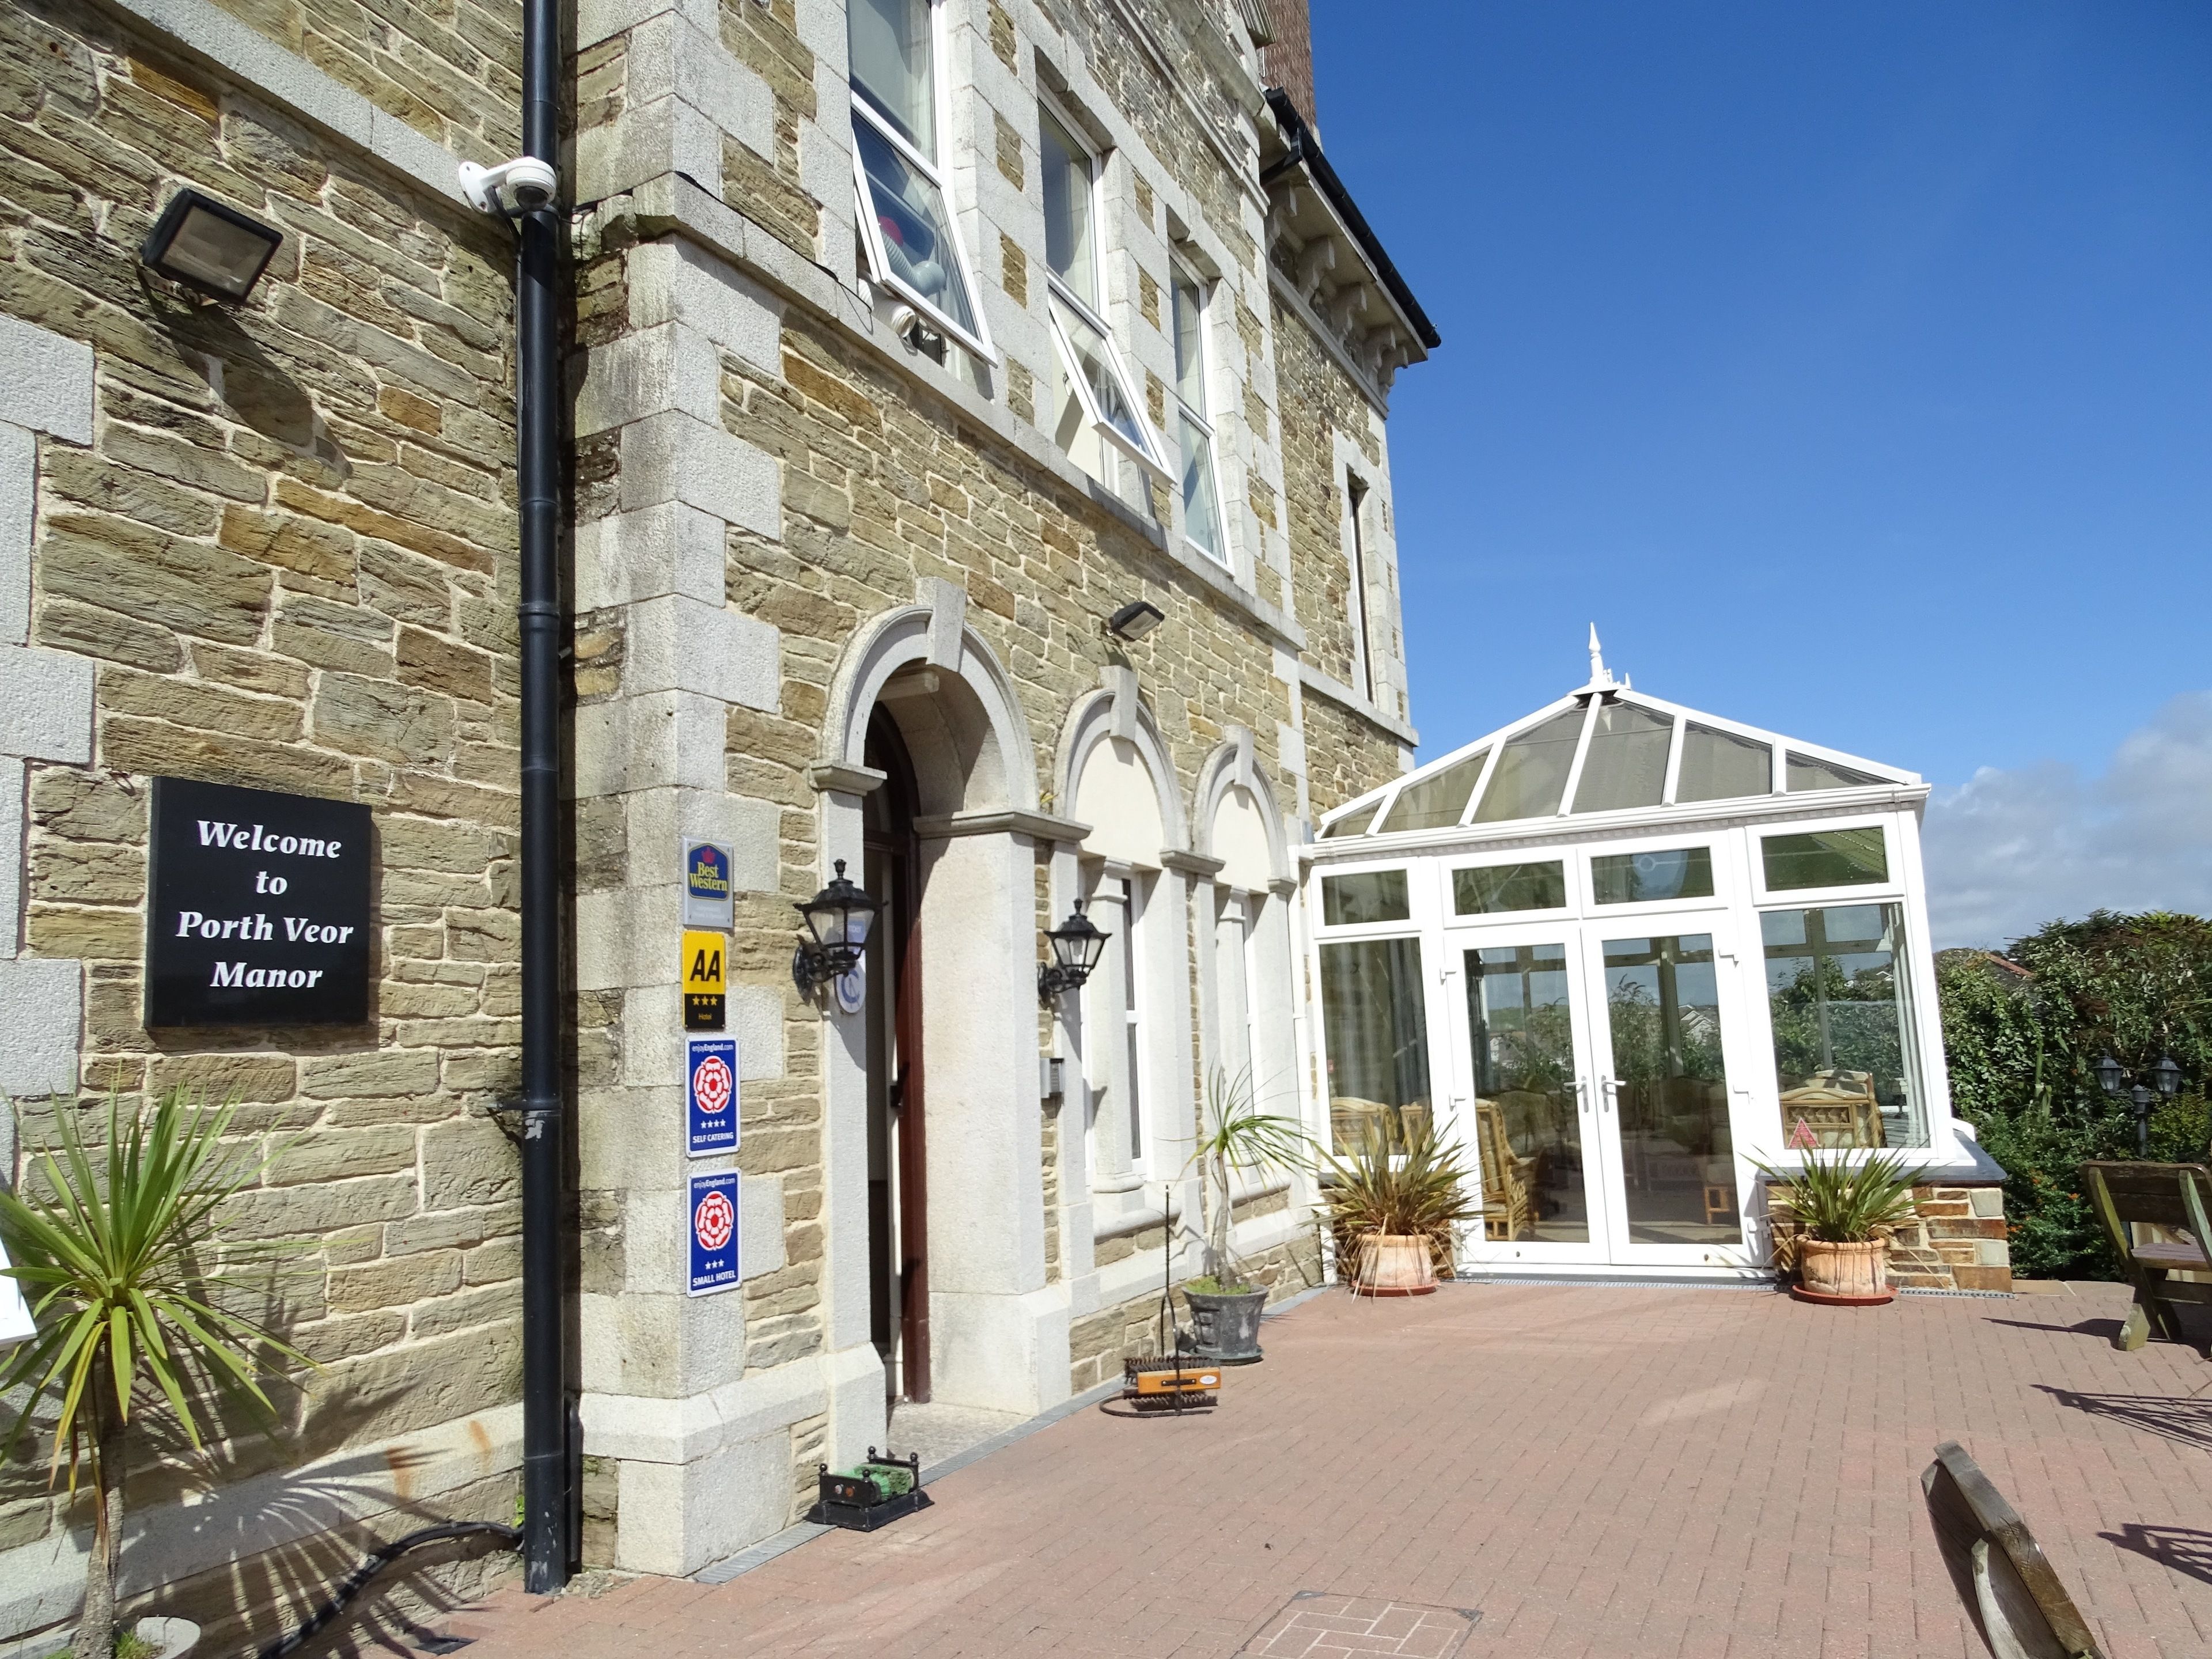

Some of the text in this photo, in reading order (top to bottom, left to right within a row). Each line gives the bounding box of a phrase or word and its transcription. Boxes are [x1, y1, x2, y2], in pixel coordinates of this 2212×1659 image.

[196, 820, 342, 858] Welcome
[698, 861, 719, 878] Best
[256, 870, 288, 895] to
[690, 873, 728, 892] Western
[175, 911, 354, 944] Porth Veor
[209, 961, 323, 988] Manor
[690, 949, 720, 982] AA
[692, 1132, 734, 1143] SELF CATERING
[692, 1270, 736, 1286] SMALL HOTEL
